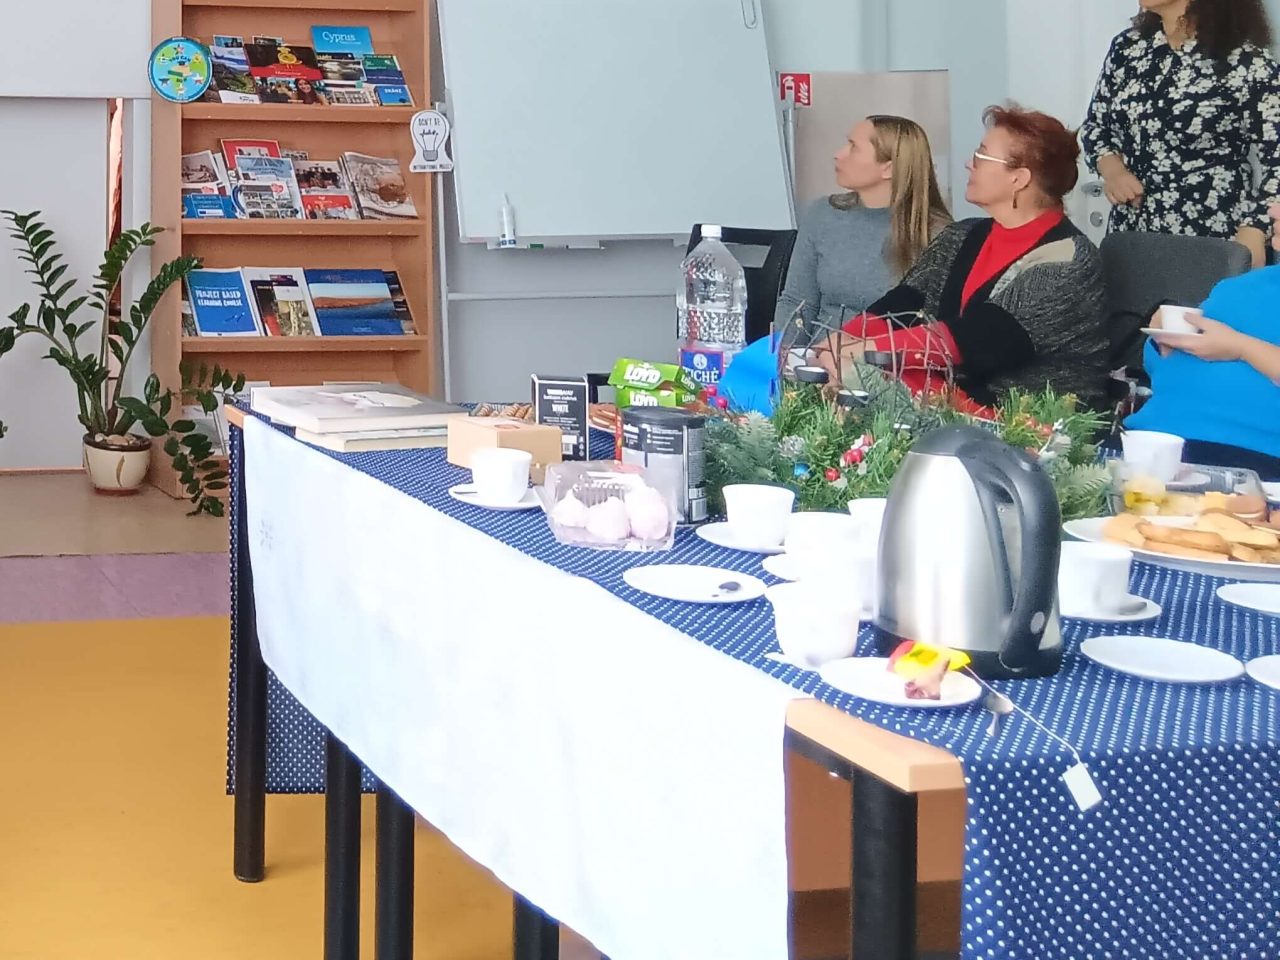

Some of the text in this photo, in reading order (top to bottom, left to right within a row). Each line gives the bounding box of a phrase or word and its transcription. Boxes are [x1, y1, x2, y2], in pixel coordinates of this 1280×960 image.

[322, 31, 356, 44] Cyprus
[195, 289, 220, 298] PROJECT
[624, 363, 661, 384] LOYD
[681, 374, 696, 390] LOYD
